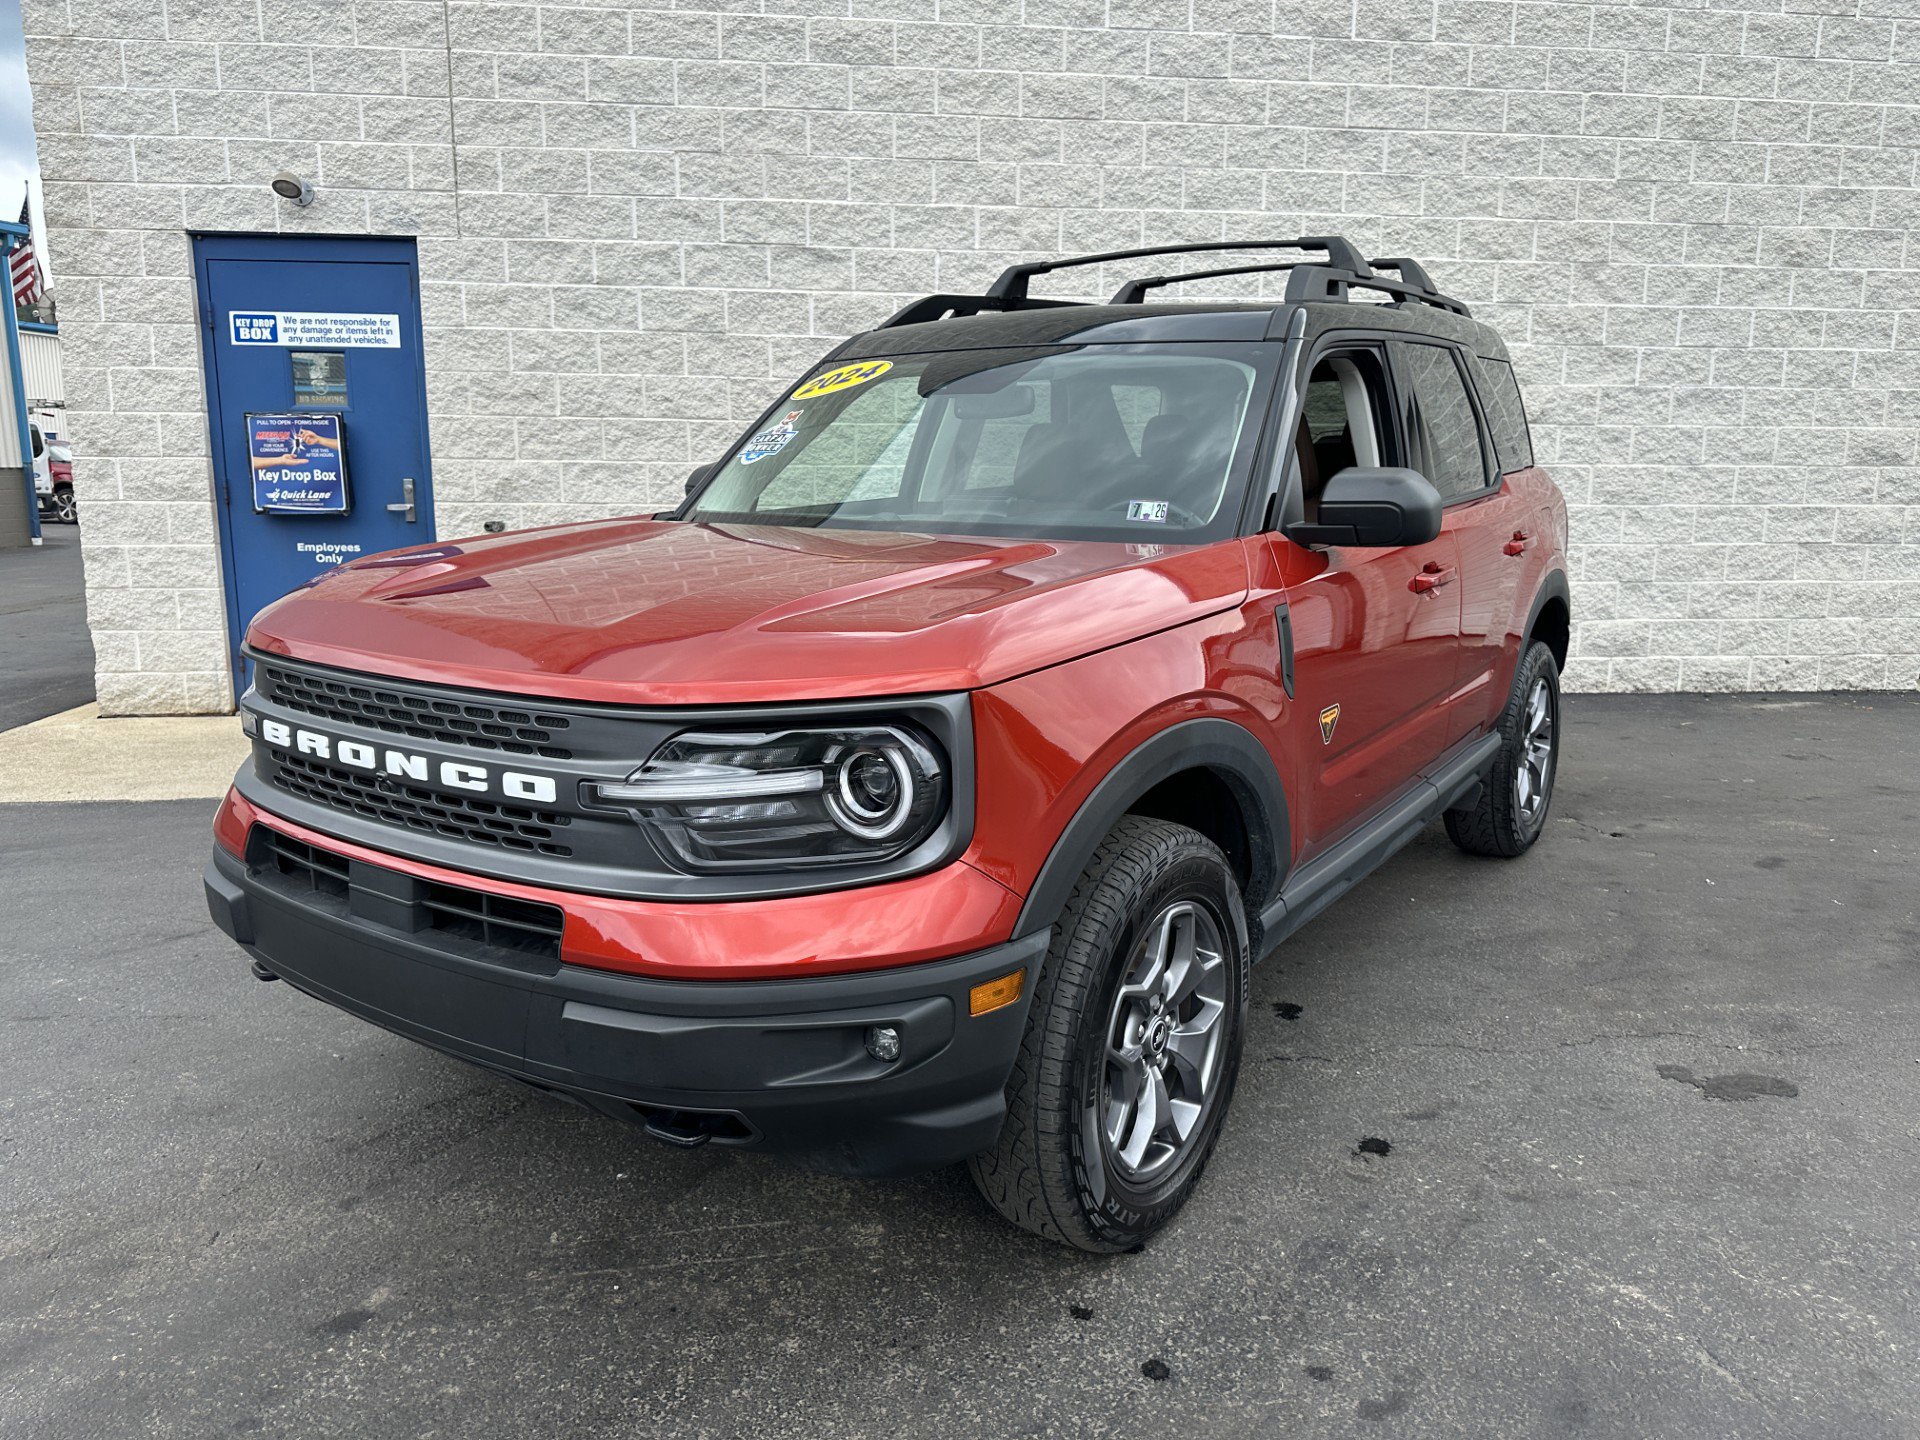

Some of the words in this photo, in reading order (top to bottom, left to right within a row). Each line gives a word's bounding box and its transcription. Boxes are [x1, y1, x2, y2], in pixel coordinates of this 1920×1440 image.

[236, 318, 251, 327] KEY
[252, 319, 275, 328] DROP
[283, 316, 297, 324] We
[315, 317, 328, 325] not
[330, 318, 376, 326] responsible
[380, 318, 390, 326] for
[240, 328, 272, 340] BOX
[301, 326, 332, 335] damage
[370, 327, 383, 335] left
[288, 336, 303, 344] any
[306, 335, 351, 343] unattended
[354, 336, 389, 344] vehicles.
[797, 363, 885, 397] 2024
[258, 470, 279, 483] Key
[282, 470, 311, 483] Drop
[313, 469, 336, 480] Box
[281, 490, 306, 499] Quick
[307, 490, 331, 498] Lane
[1133, 503, 1141, 518] 7
[1155, 504, 1166, 518] 26
[297, 543, 361, 553] Employees
[316, 554, 343, 564] Only
[262, 719, 557, 803] BRONCO
